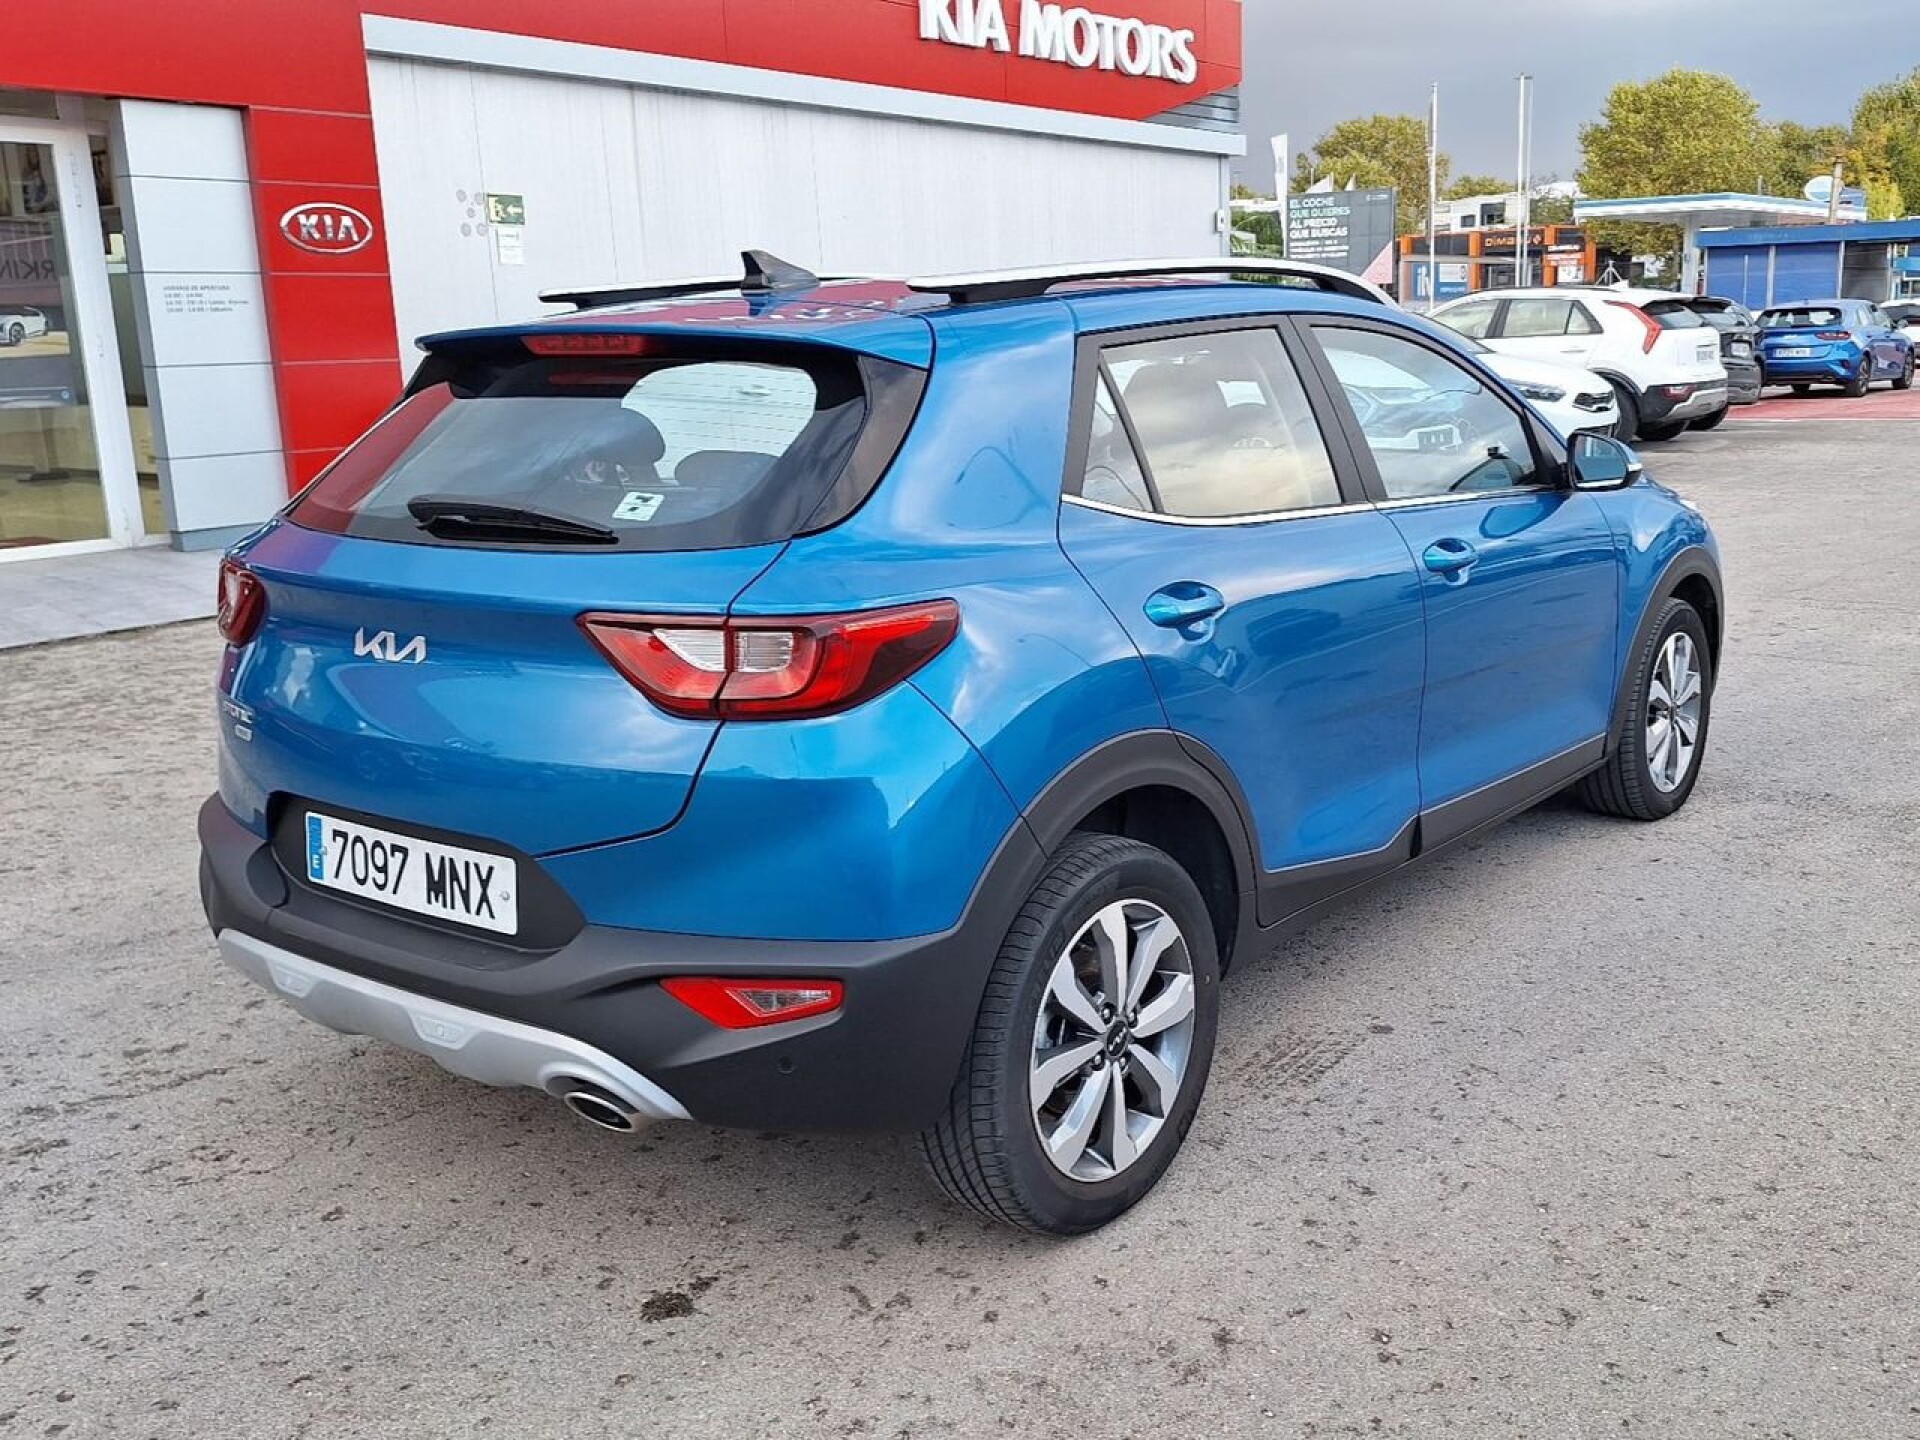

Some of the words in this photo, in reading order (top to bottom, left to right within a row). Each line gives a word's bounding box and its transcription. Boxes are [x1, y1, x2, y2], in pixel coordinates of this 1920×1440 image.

[917, 0, 1011, 52] KIA
[1018, 0, 1198, 84] MOTORS
[1289, 208, 1310, 218] QUE
[1310, 206, 1350, 217] QUIERES
[1302, 197, 1335, 208] COCHE
[297, 213, 359, 242] KIA
[1289, 219, 1302, 229] AL
[1302, 217, 1338, 228] PRECIO
[1289, 229, 1310, 239] QUE
[1310, 226, 1348, 237] BUSCAS
[354, 626, 427, 664] KIA
[311, 854, 320, 869] E
[332, 829, 409, 895] 7097
[425, 852, 496, 920] MNX
